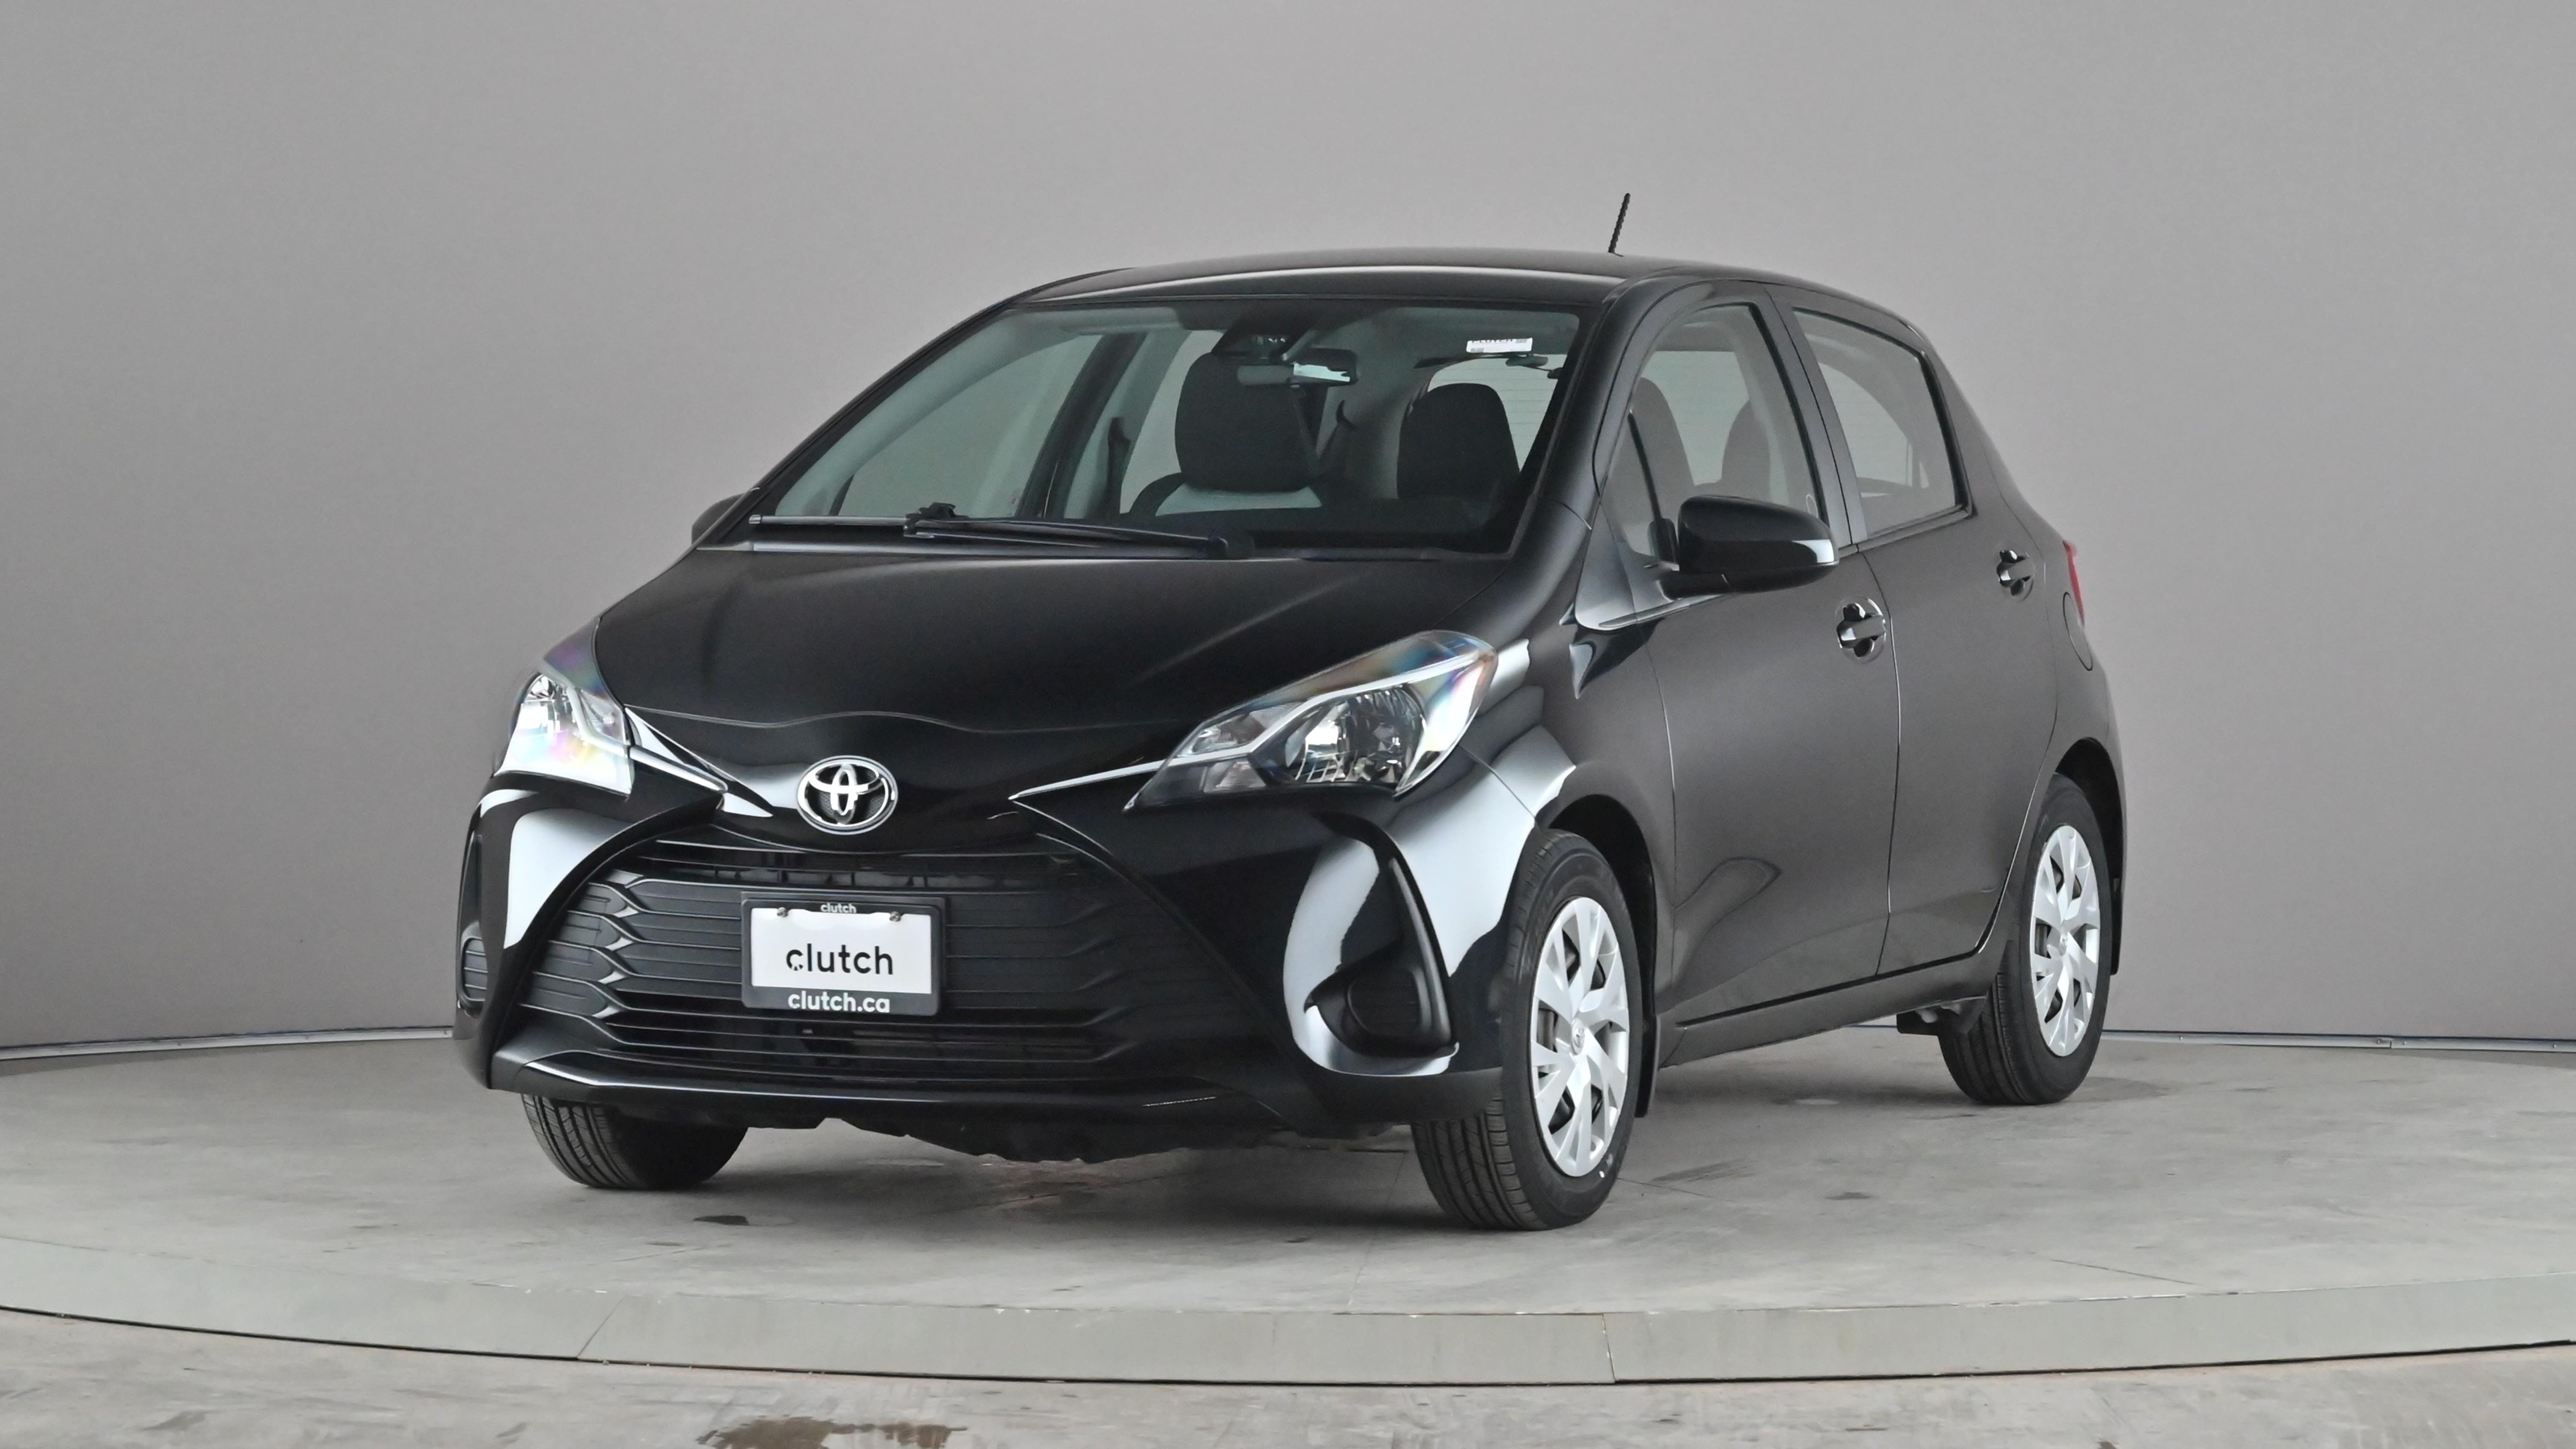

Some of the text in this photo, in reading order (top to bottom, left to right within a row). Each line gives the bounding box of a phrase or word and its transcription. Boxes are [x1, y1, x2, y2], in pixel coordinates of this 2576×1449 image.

[821, 903, 856, 913] clutch
[787, 943, 893, 975] clutch
[788, 990, 890, 1013] clutch.ca
